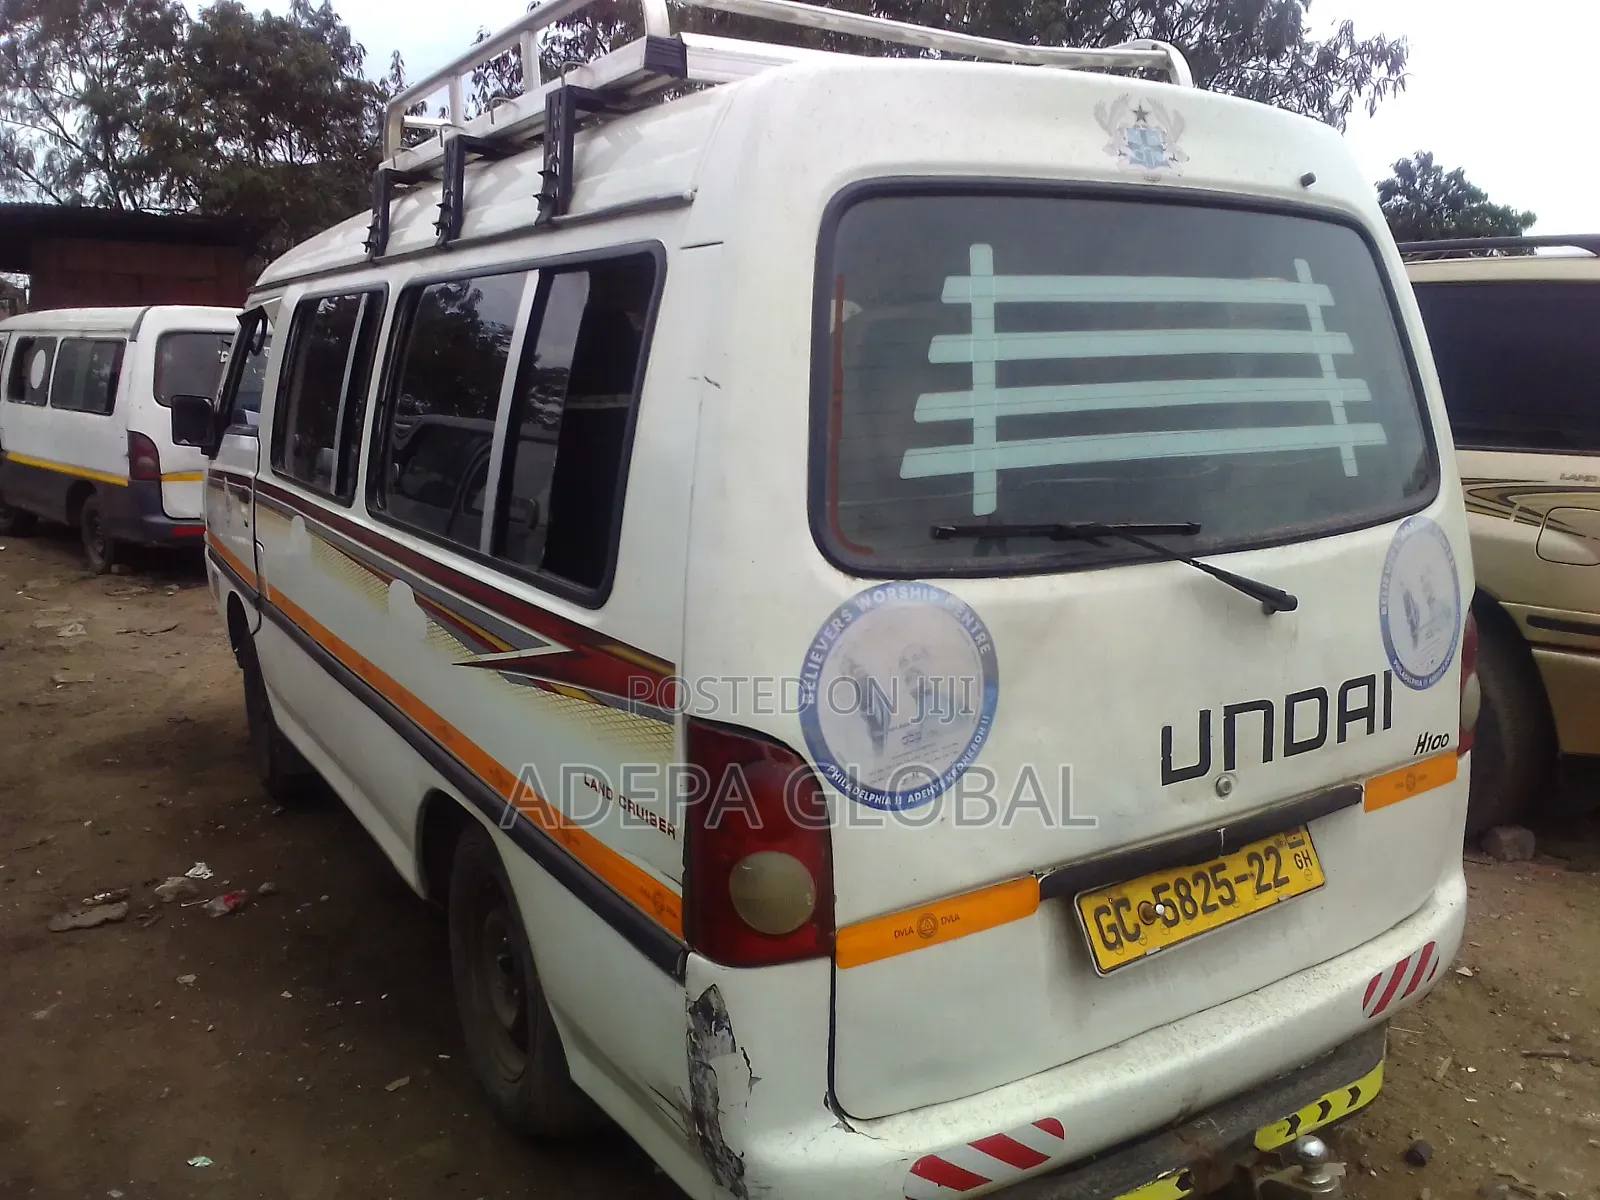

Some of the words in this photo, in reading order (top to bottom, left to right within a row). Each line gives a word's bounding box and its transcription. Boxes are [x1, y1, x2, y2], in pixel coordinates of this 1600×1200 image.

[801, 608, 853, 704] BELIEVERS
[856, 586, 939, 612] WORSHIP
[1413, 731, 1450, 756] H100
[584, 771, 613, 801] LAND
[827, 764, 891, 805] PHILADELPHIA
[1293, 849, 1313, 870] GH
[1094, 899, 1141, 951] GC
[1151, 845, 1290, 928] 5825-22
[894, 926, 915, 939] DVLA
[940, 913, 960, 926] DVLA
